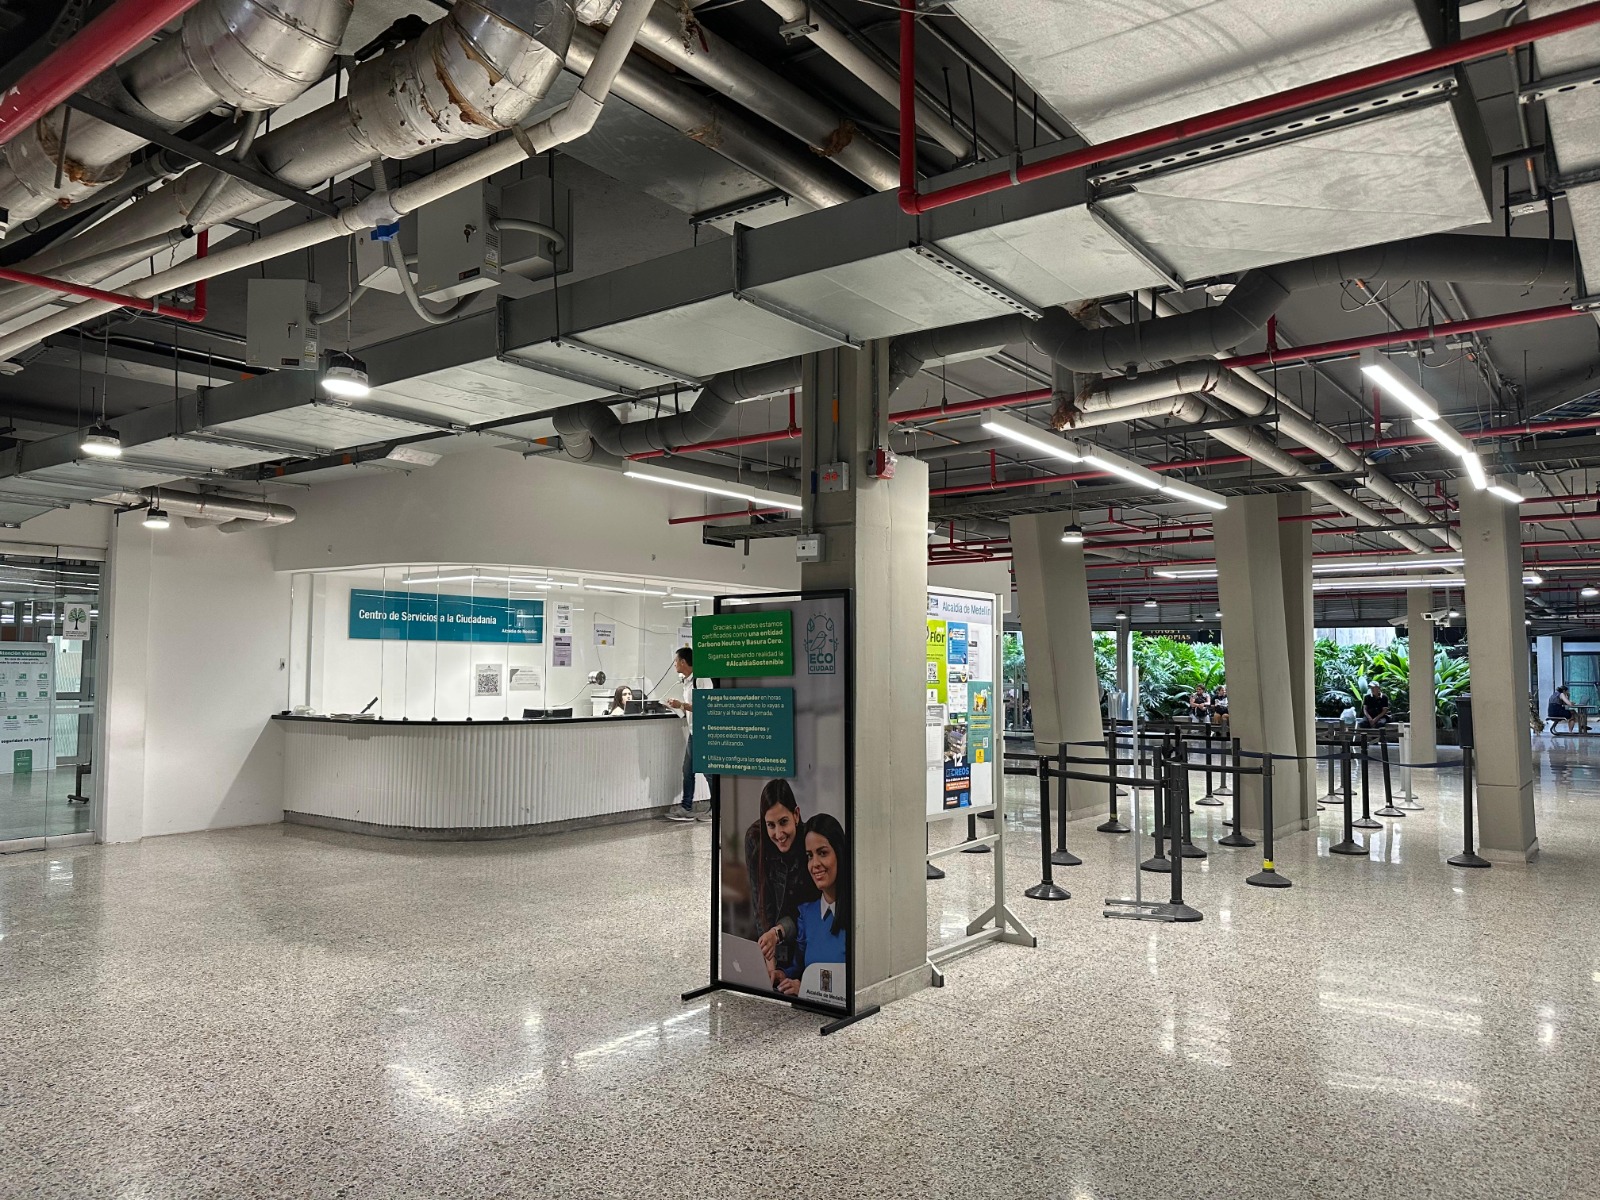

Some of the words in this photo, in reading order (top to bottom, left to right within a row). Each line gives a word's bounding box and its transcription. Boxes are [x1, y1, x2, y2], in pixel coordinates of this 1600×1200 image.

[942, 602, 963, 614] Alcaldía
[964, 604, 970, 614] de
[971, 604, 991, 615] Medellín
[359, 609, 387, 620] Centro
[389, 610, 399, 621] de
[401, 611, 438, 622] Servicios
[440, 615, 445, 623] a
[447, 613, 454, 623] la
[702, 632, 732, 640] certificados
[930, 631, 945, 643] Flor
[697, 640, 721, 648] Carbono
[721, 639, 741, 647] Neutro
[746, 638, 767, 646] Basura
[767, 637, 784, 645] Cero.
[707, 653, 730, 661] Sigamos
[809, 653, 833, 664] ECO
[953, 753, 963, 767] 12
